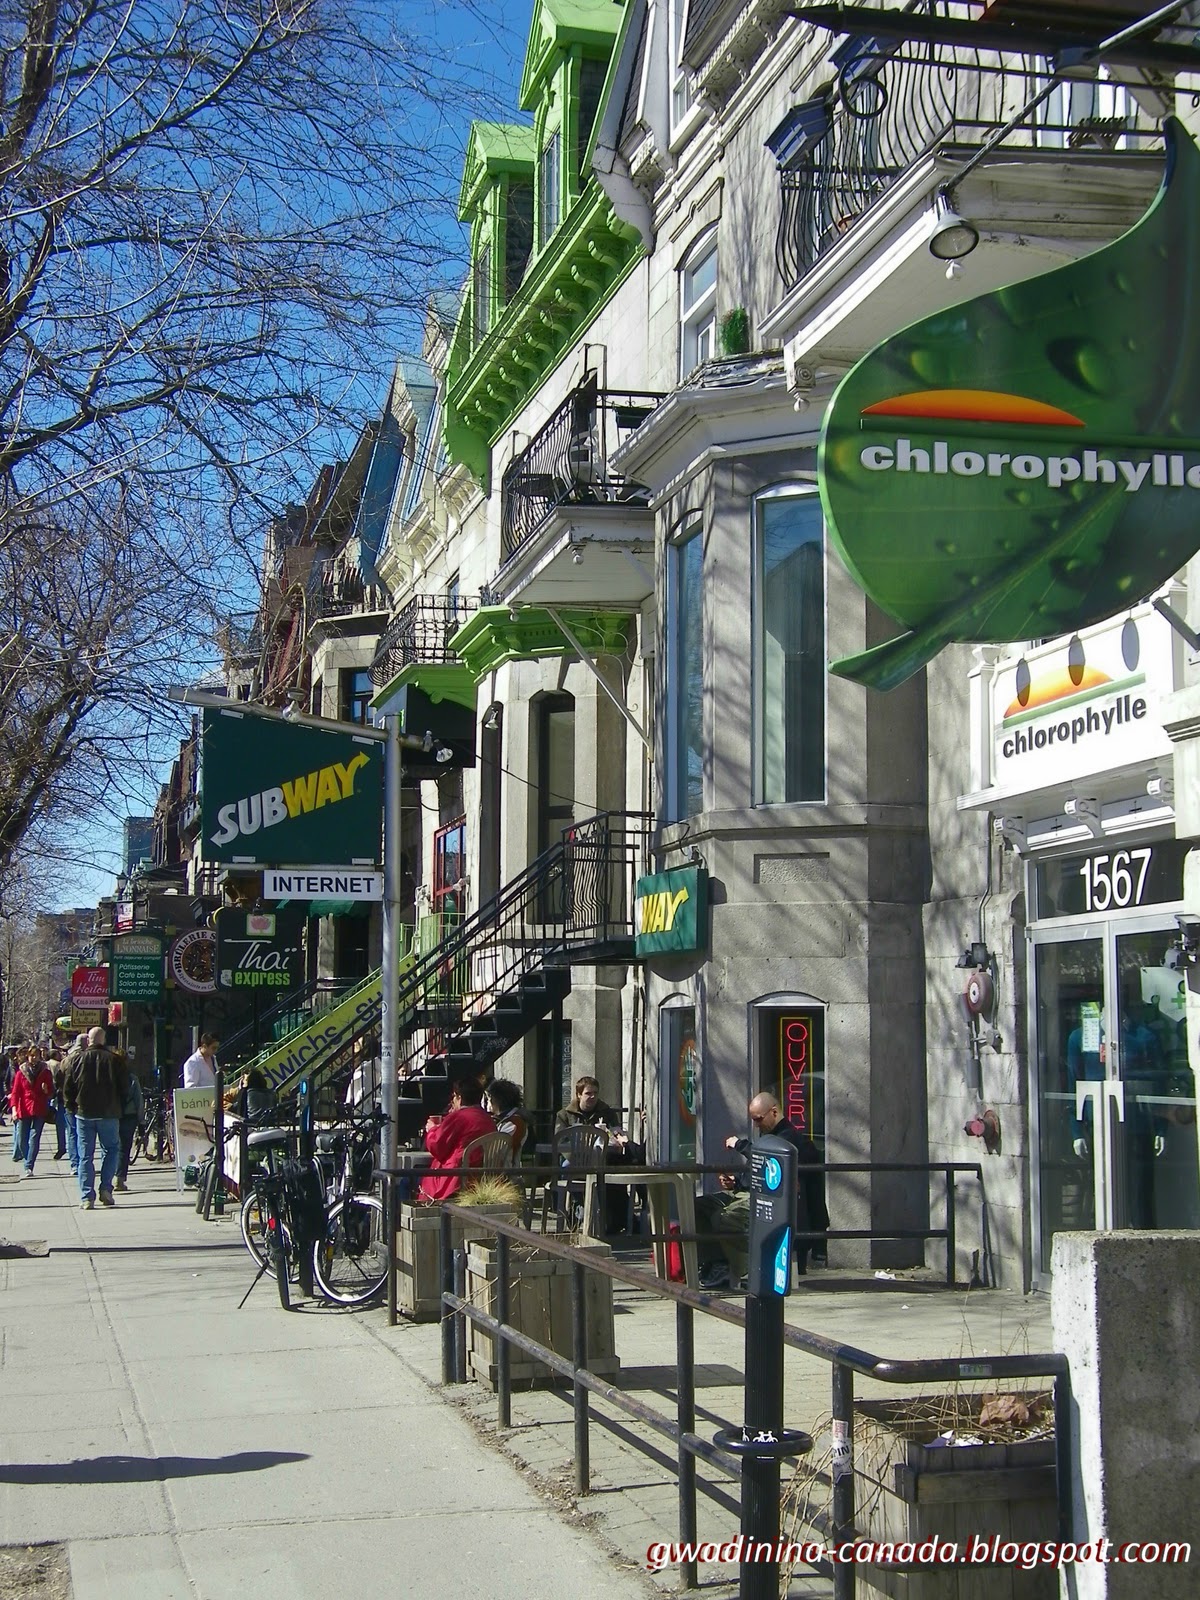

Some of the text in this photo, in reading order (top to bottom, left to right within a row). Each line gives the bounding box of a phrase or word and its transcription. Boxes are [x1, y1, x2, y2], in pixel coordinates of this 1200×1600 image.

[1002, 694, 1147, 759] chlorophylle
[210, 751, 371, 848] SUBWAY
[272, 876, 375, 893] INTERNET
[1079, 847, 1152, 911] 1567
[223, 938, 298, 971] Thaï
[118, 979, 137, 987] Salon
[138, 979, 148, 987] de
[136, 971, 155, 979] bistro
[234, 971, 291, 987] express
[181, 1098, 210, 1109] bánh
